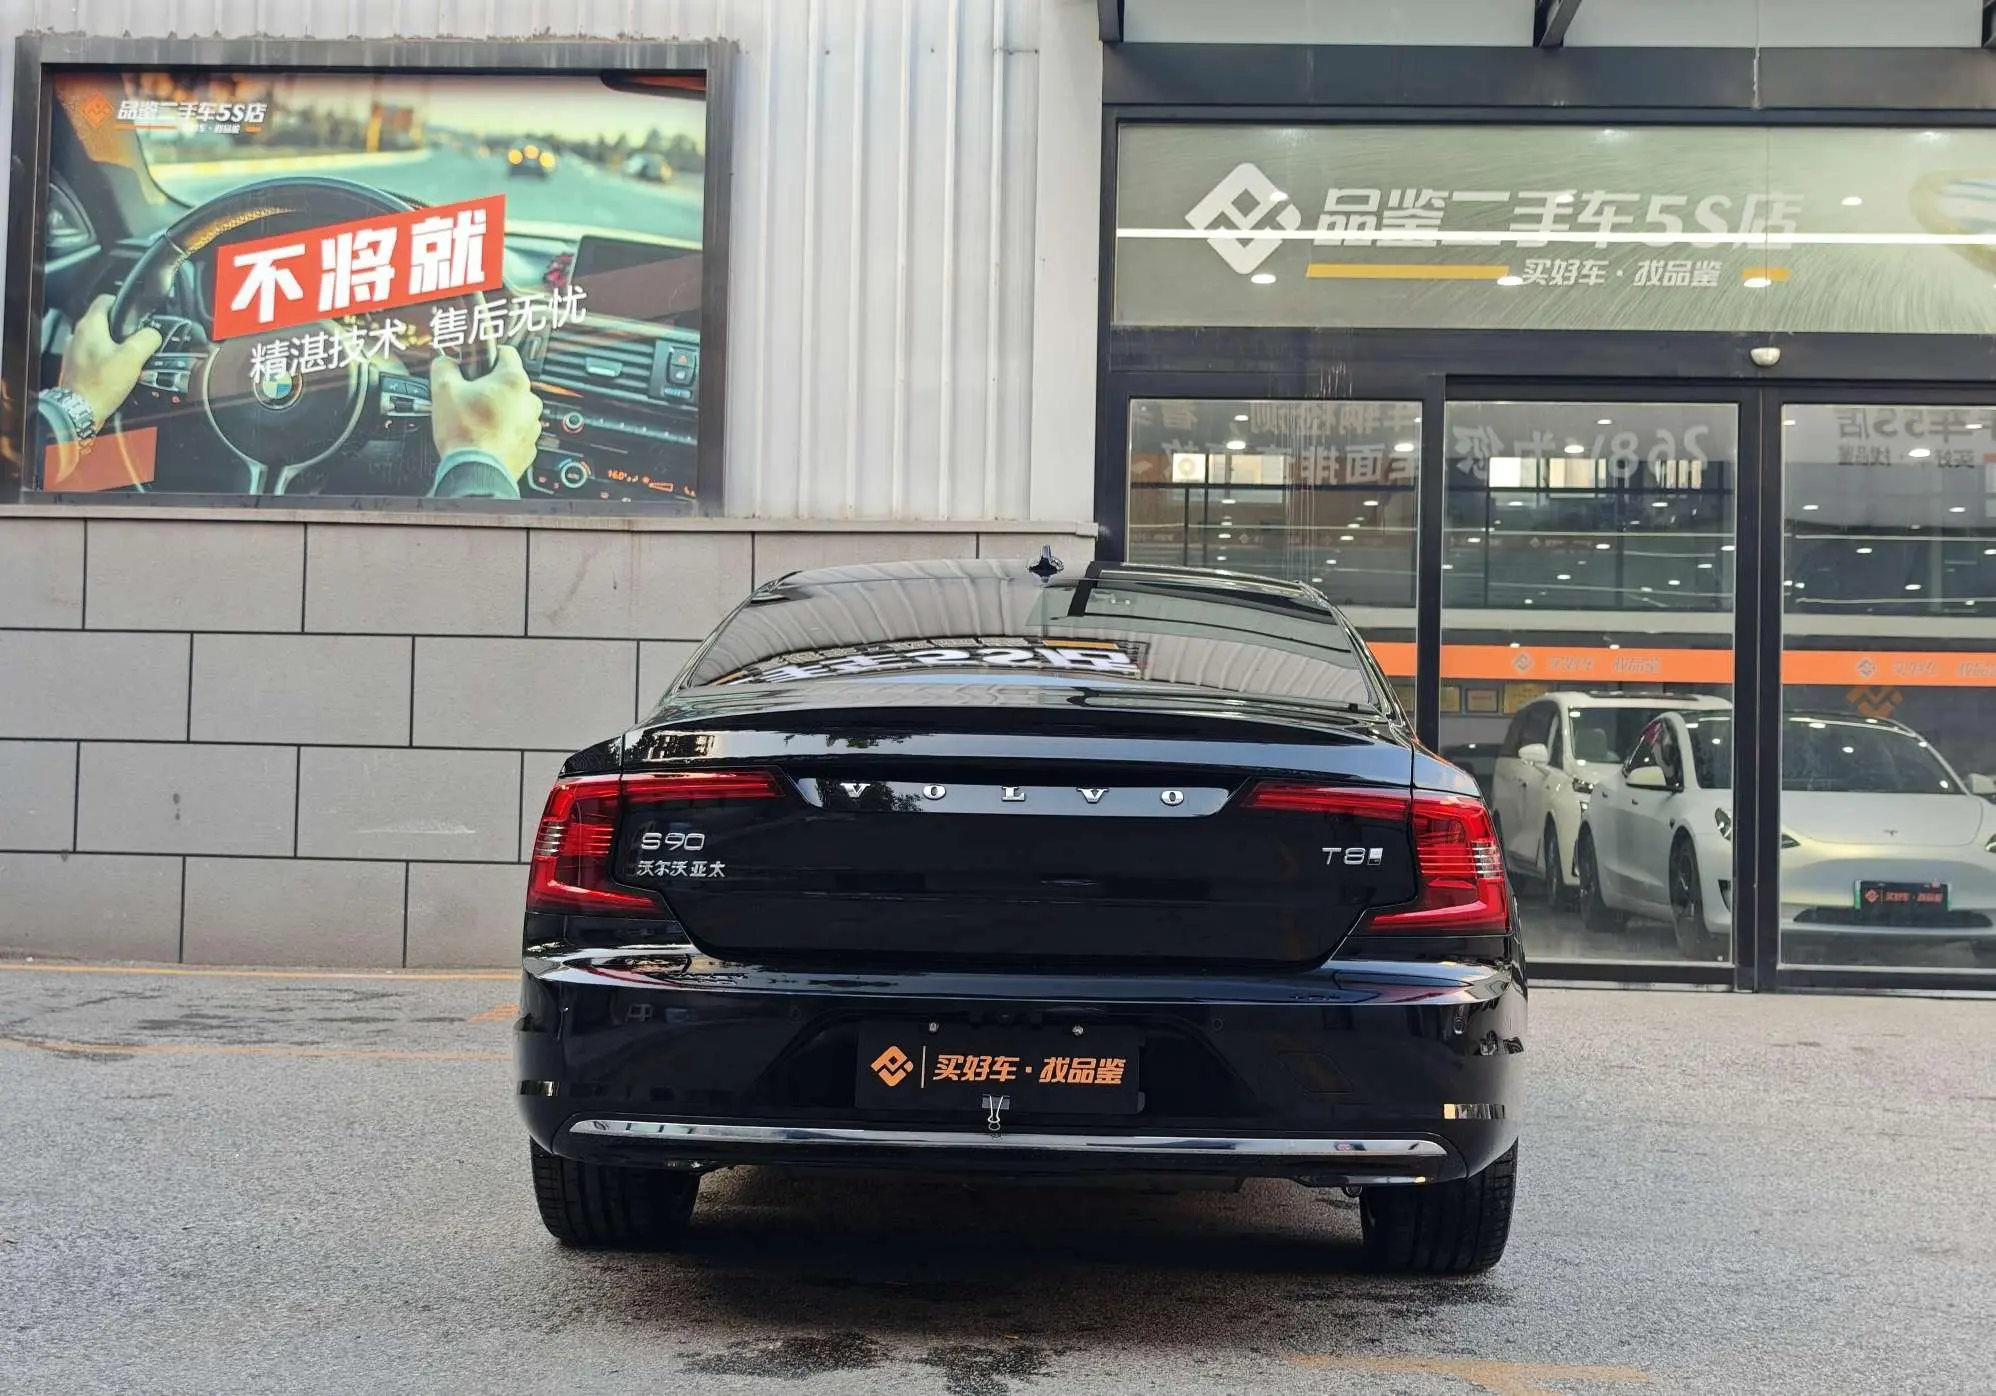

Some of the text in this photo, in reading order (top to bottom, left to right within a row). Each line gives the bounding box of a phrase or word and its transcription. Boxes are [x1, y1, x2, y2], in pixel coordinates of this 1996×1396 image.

[117, 100, 267, 123] 品鉴二手车5S店
[1313, 188, 1804, 250] 品鉴二手车5S店
[230, 208, 487, 324] 不将就
[249, 285, 588, 382] 精湛技术 售后无忧
[840, 782, 1185, 806] VOLVO
[641, 832, 705, 851] S90
[1321, 847, 1366, 865] T8
[636, 860, 726, 878] 沃尔沃亚太
